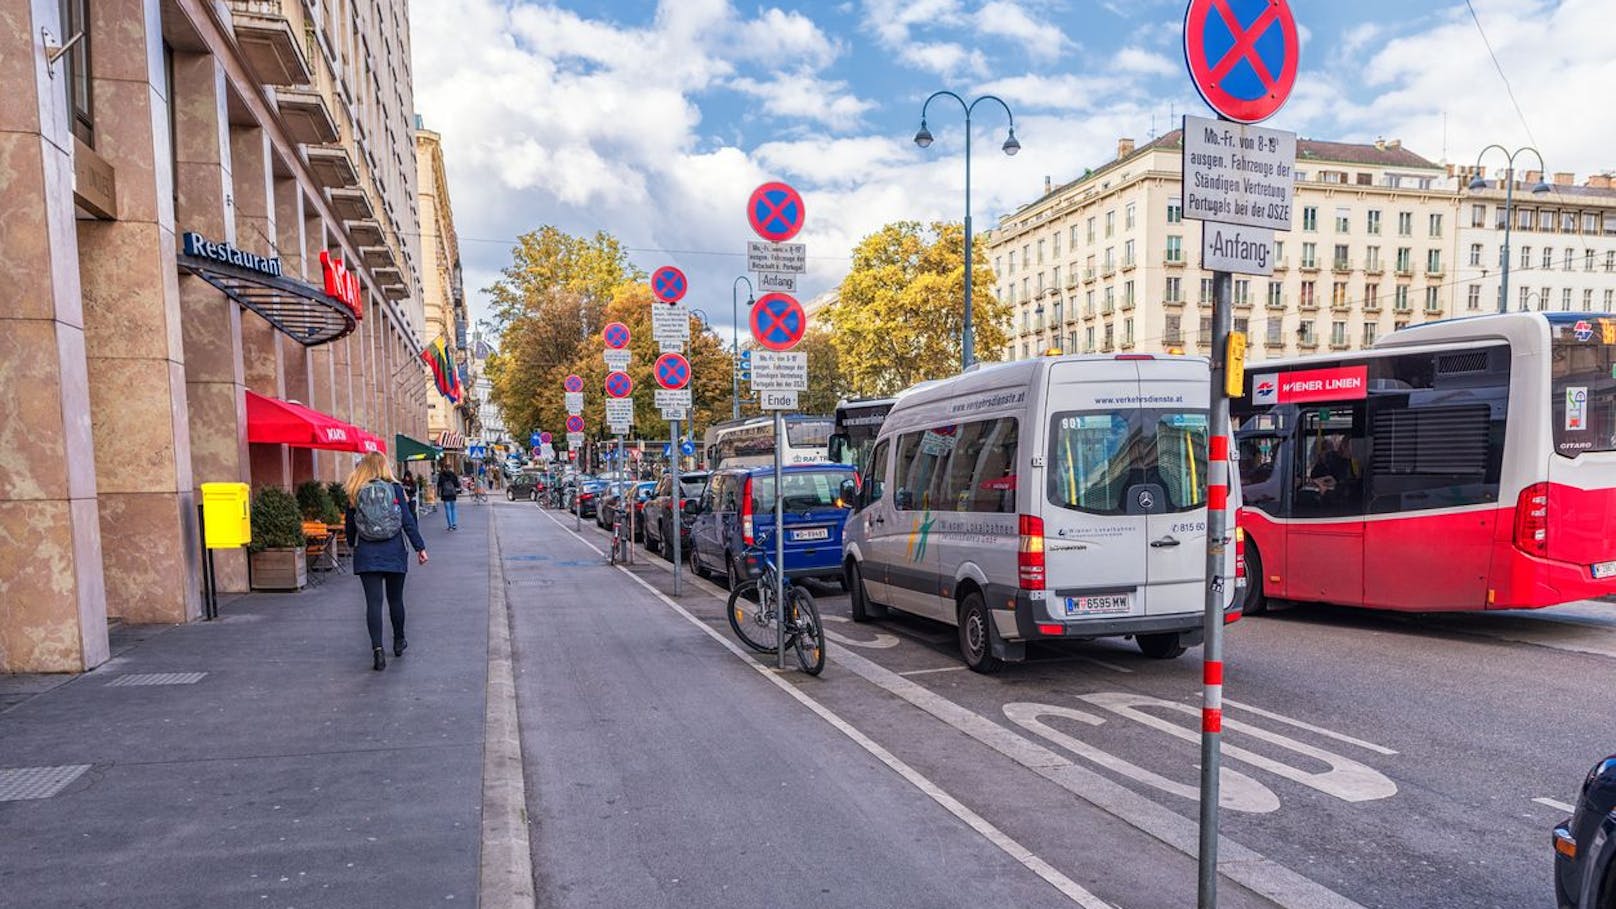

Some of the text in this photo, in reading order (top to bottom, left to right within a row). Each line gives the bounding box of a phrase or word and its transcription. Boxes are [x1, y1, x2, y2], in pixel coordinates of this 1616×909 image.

[1204, 127, 1235, 148] Mo.-Fr.
[1239, 136, 1254, 149] von
[1190, 151, 1290, 178] ausgen. Fahrzeuge der
[1194, 171, 1286, 201] Ständigen Vertretung
[1189, 193, 1289, 221] Portugals bei der OSZE
[191, 232, 283, 277] Restaurant
[1213, 231, 1267, 268] Anfang
[762, 274, 793, 289] Anfang
[1282, 377, 1360, 392] WIENER LINIEN
[767, 394, 791, 406] Ende
[1180, 522, 1205, 532] 815 60
